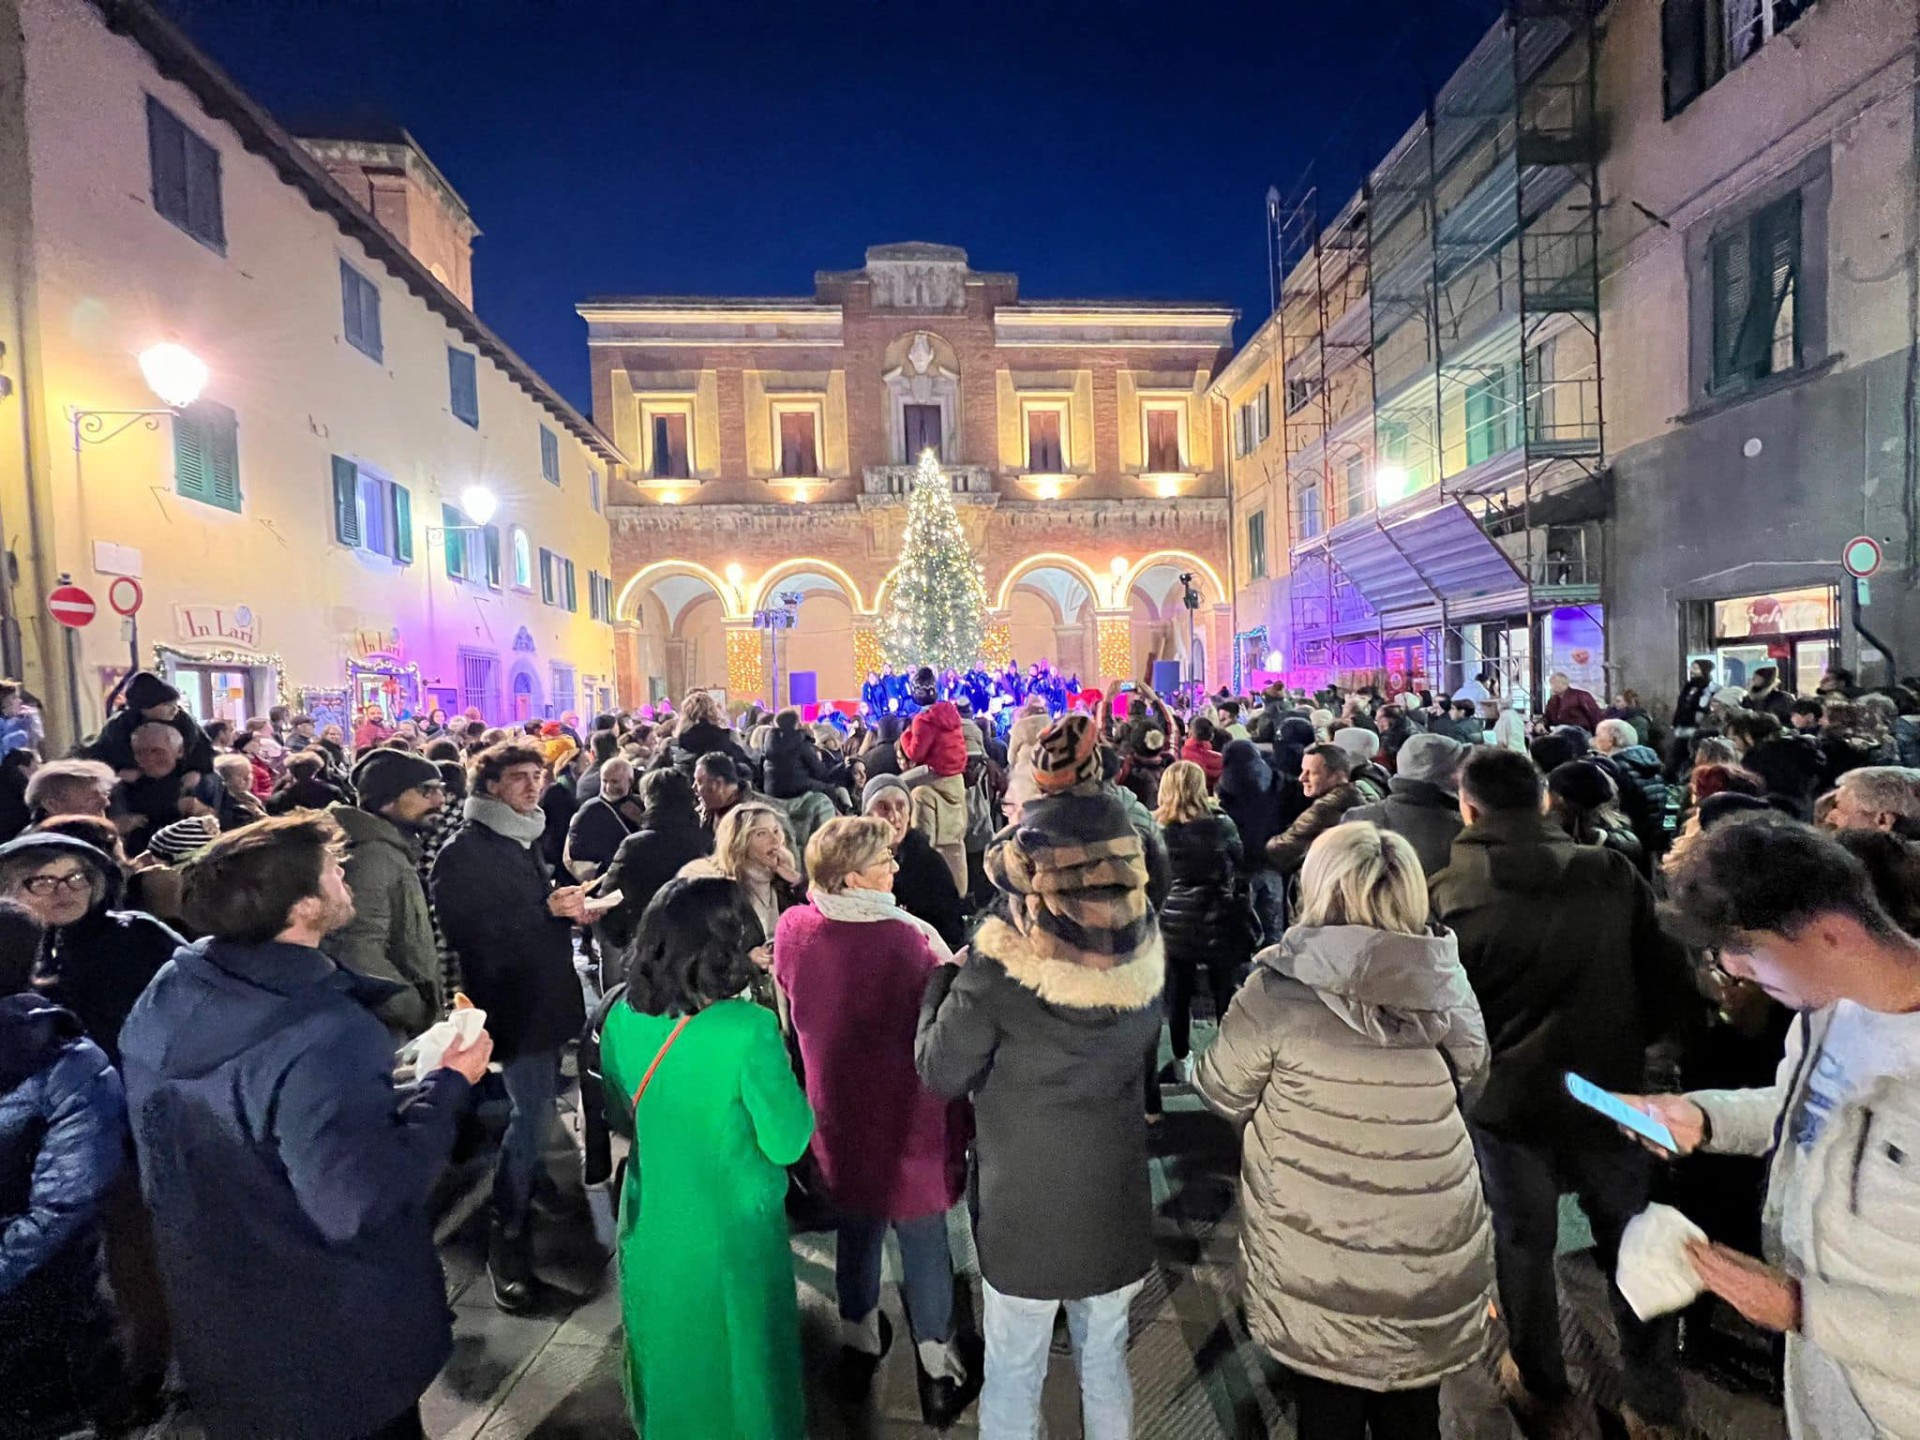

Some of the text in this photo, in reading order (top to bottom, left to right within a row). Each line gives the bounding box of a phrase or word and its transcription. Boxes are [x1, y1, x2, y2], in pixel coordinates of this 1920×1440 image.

[184, 609, 254, 644] In Lari
[360, 632, 376, 654] In
